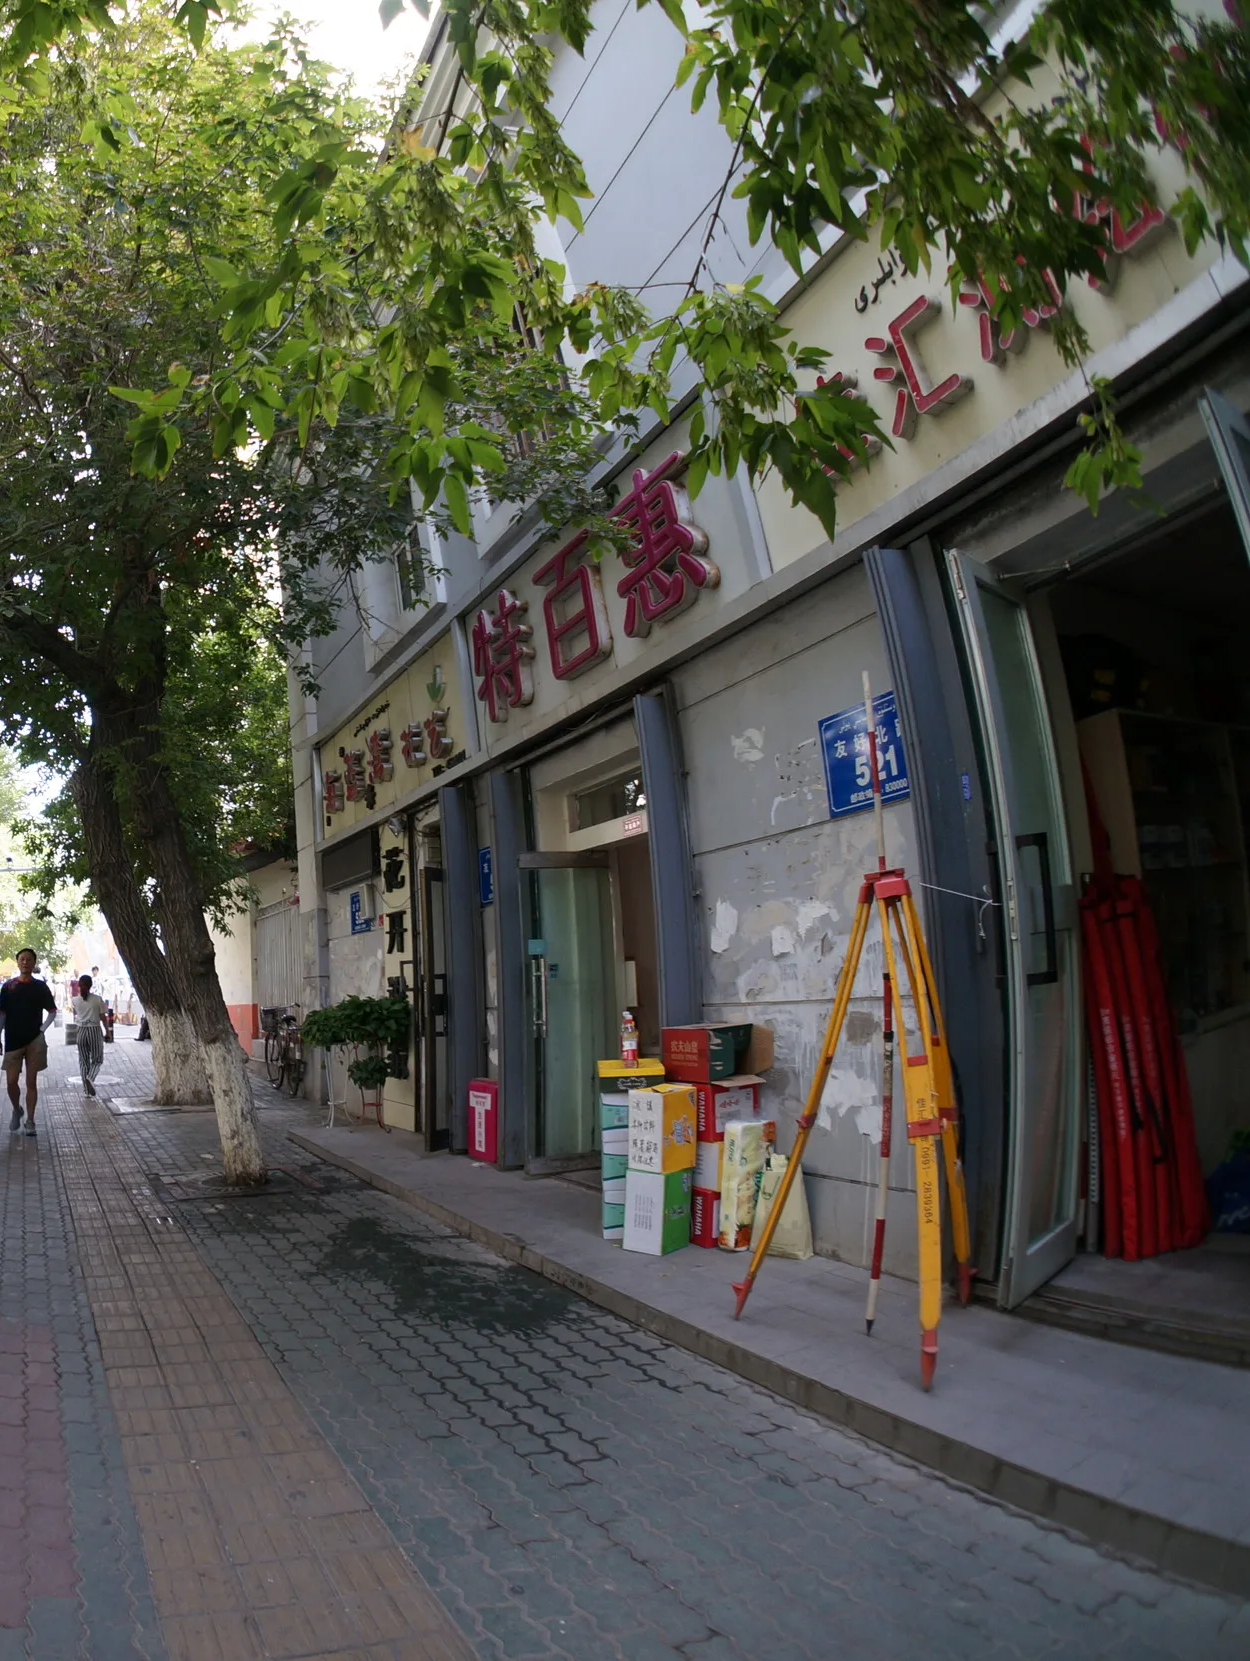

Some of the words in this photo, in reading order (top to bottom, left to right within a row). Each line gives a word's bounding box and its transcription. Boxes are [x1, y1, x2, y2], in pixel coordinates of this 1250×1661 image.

[472, 450, 707, 724] 特百惠
[855, 745, 898, 786] 521
[698, 1091, 706, 1132] WAHAHA
[694, 1196, 703, 1235] WAHAHA
